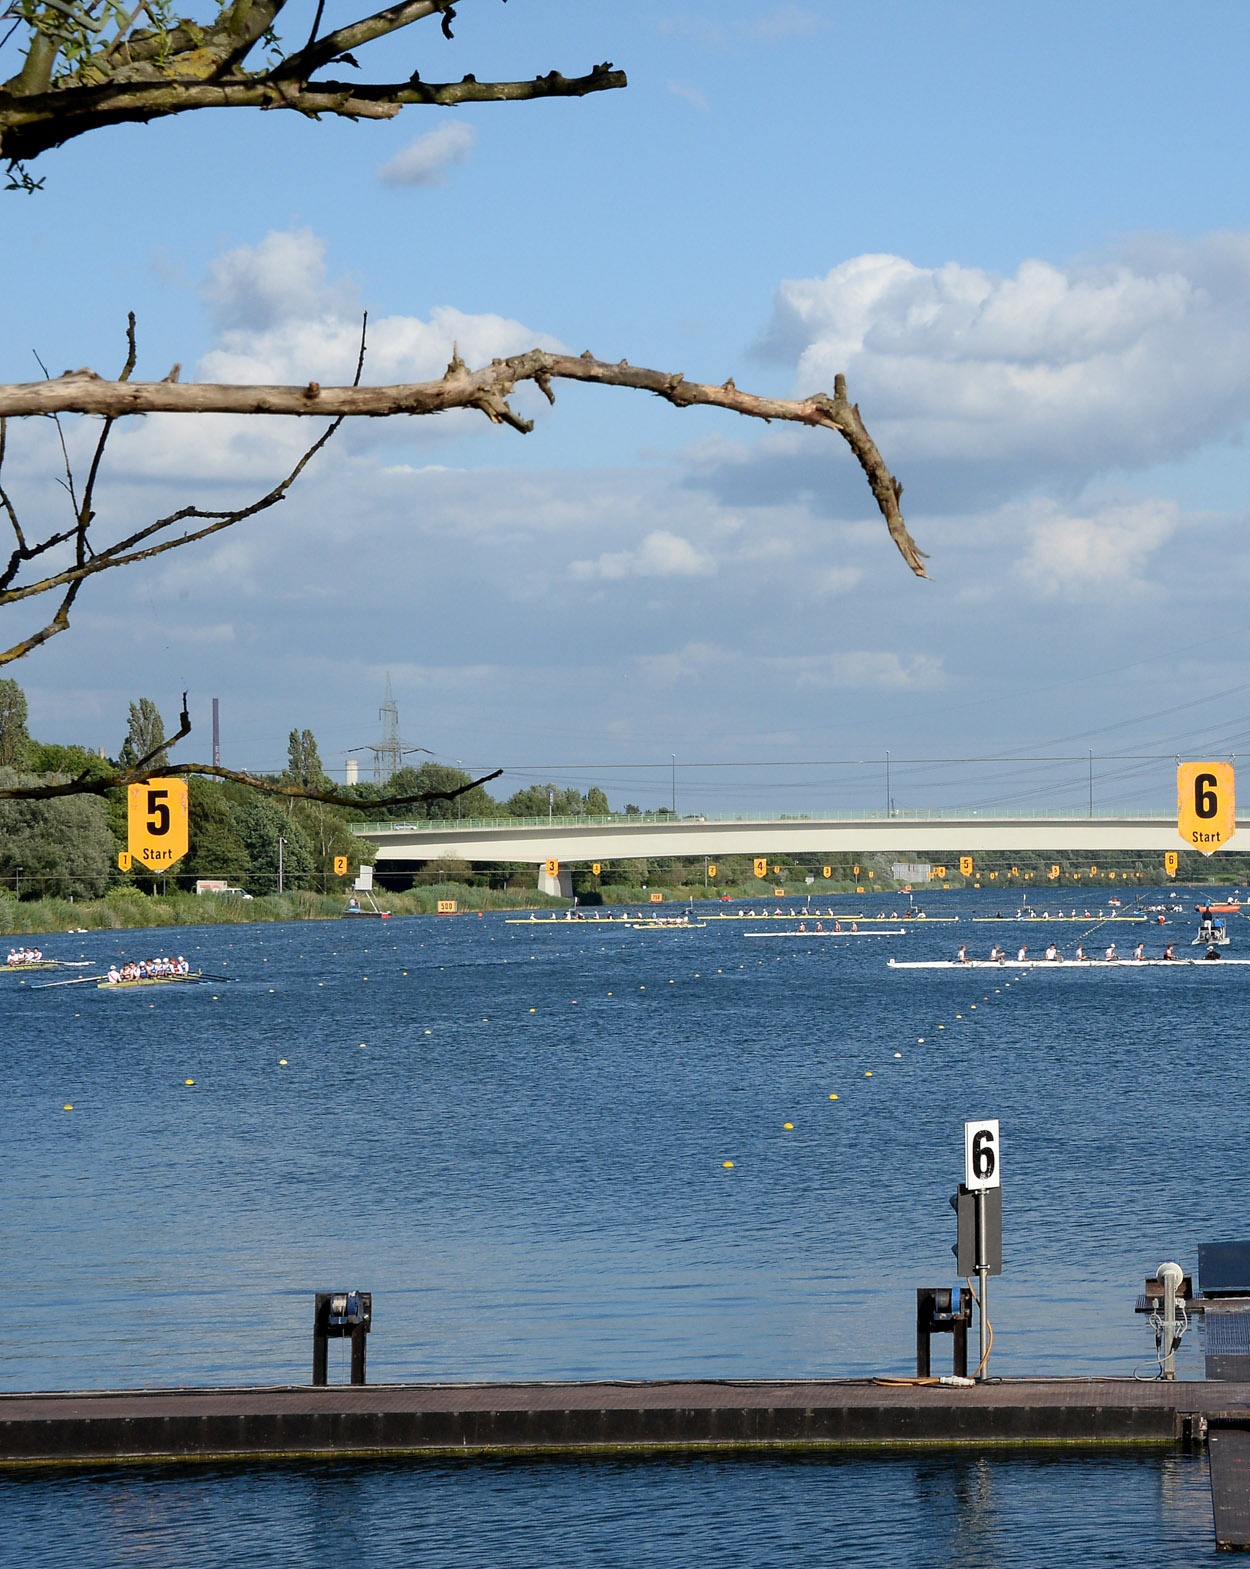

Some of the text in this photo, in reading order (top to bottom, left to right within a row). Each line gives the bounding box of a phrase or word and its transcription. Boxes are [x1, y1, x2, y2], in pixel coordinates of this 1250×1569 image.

[1195, 773, 1217, 819] 6
[147, 790, 170, 836] 5
[1192, 831, 1221, 843] Start
[143, 848, 172, 860] Start
[123, 855, 127, 864] 1
[338, 859, 343, 868] 2
[964, 860, 968, 868] 5
[1169, 855, 1174, 864] 6
[550, 861, 554, 871] 3
[758, 861, 762, 871] 4
[972, 1129, 995, 1180] 6
